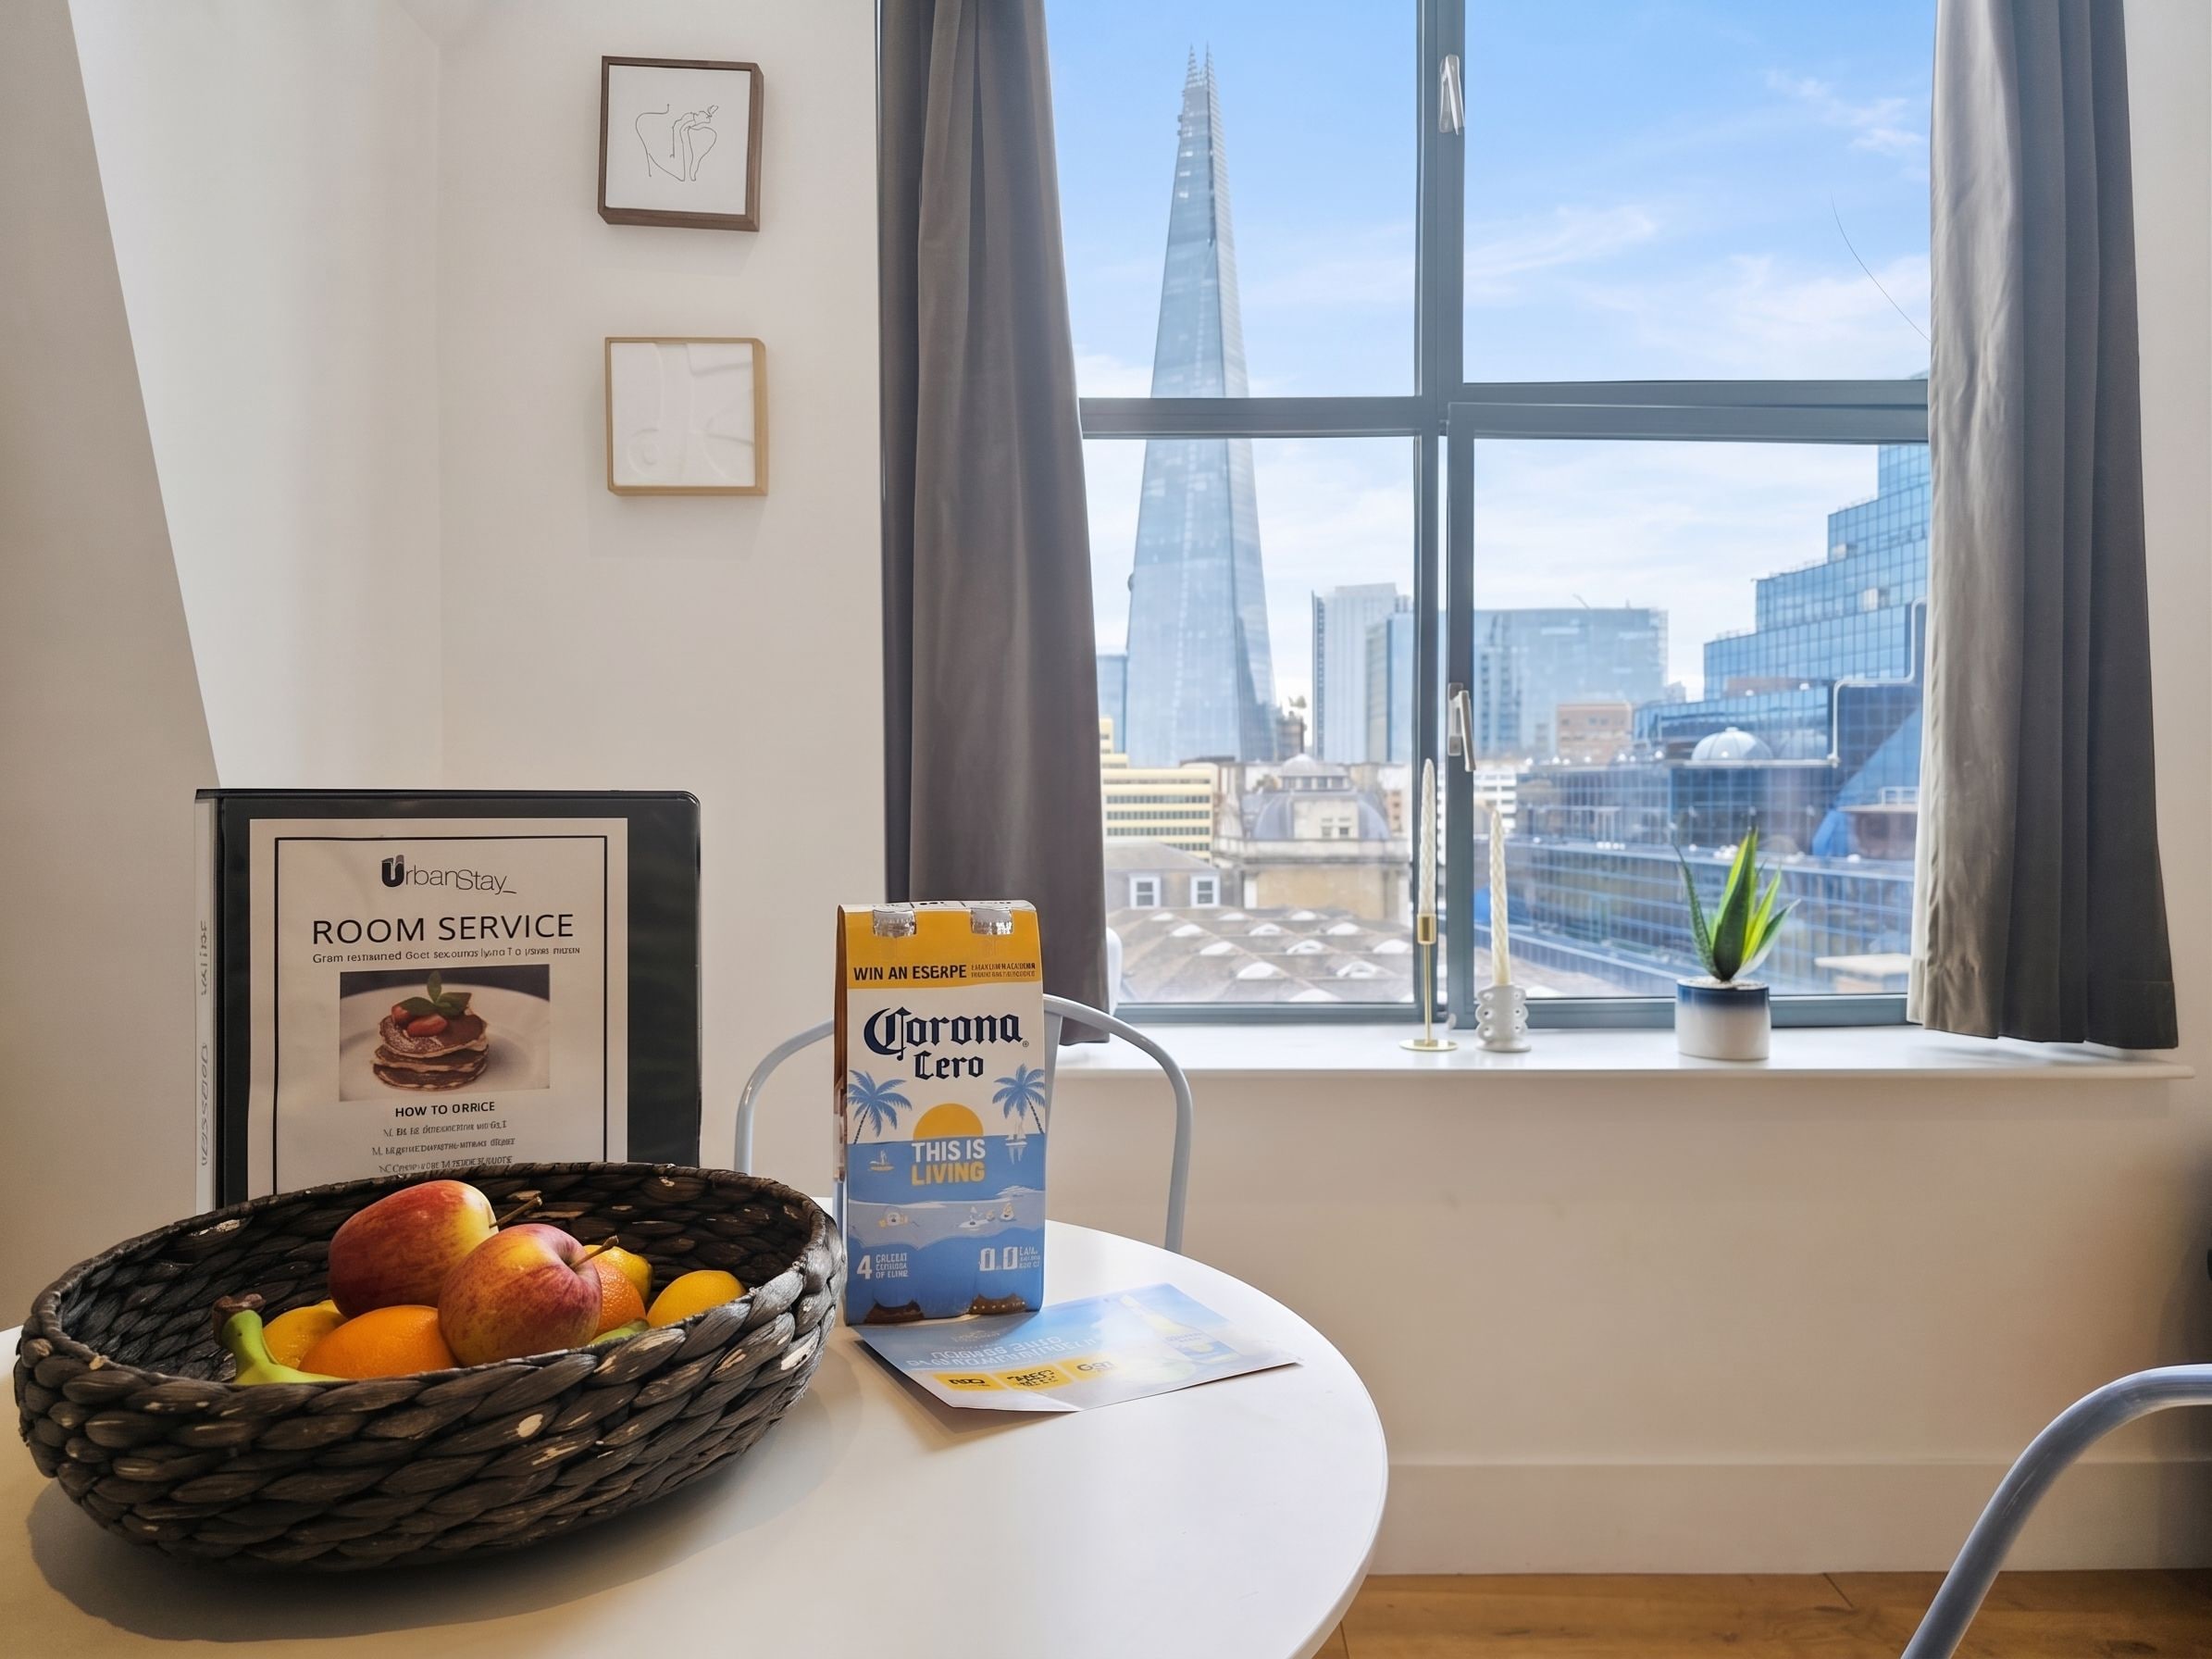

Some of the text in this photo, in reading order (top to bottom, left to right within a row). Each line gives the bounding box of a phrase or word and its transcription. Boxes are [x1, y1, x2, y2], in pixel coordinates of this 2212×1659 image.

[312, 913, 574, 945] ROOM SERVICE
[852, 967, 884, 981] WIN
[888, 966, 908, 980] AN
[864, 1006, 1024, 1061] Corona
[913, 1050, 985, 1080] Cero
[394, 1105, 428, 1117] HOW
[430, 1104, 448, 1116] TO
[911, 1138, 987, 1163] THIS IS
[911, 1160, 986, 1186] LIVING
[856, 1254, 873, 1279] 4
